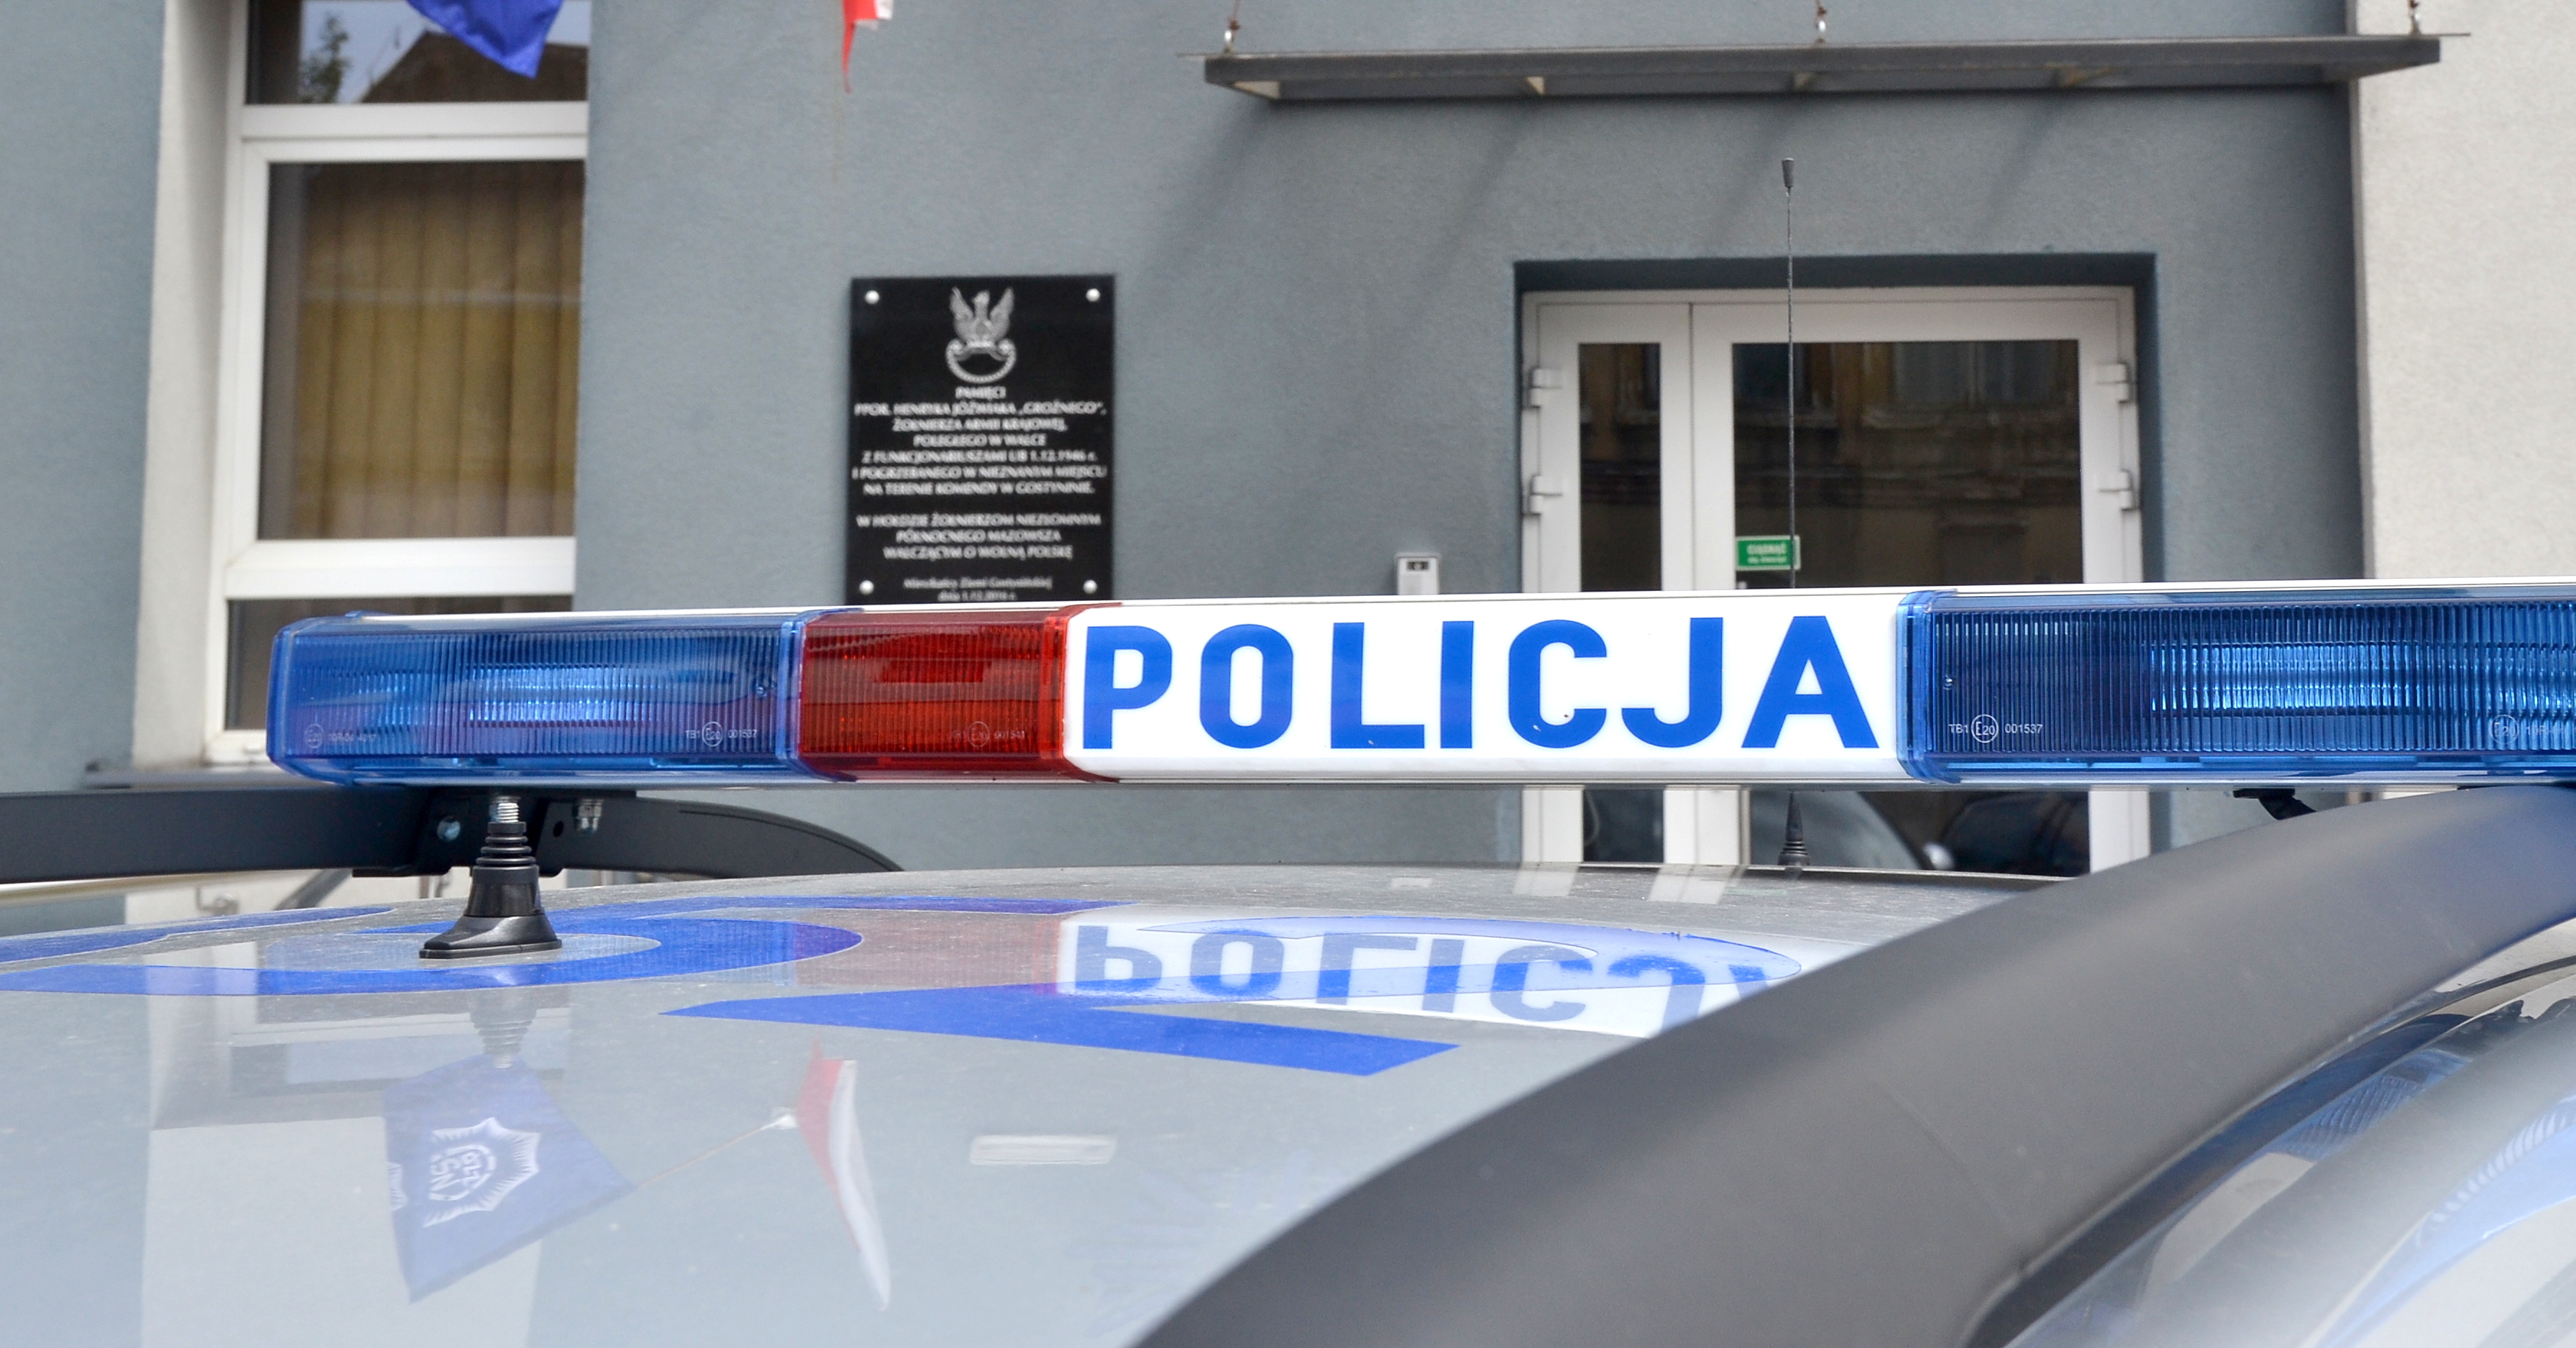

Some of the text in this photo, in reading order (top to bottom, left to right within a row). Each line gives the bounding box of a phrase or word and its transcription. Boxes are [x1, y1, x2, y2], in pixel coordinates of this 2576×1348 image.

[964, 418, 1000, 430] ARMII
[988, 434, 1002, 446] W
[1004, 434, 1046, 446] WALCE
[863, 451, 872, 463] Z
[963, 467, 976, 477] W
[864, 483, 884, 495] NA
[885, 482, 933, 495] TERENIE
[1000, 482, 1013, 493] W
[856, 515, 871, 527] W
[963, 546, 976, 559] O
[1081, 615, 1880, 750] POLICJA
[1948, 723, 1969, 733] TB1
[2004, 723, 2043, 733] 001537
